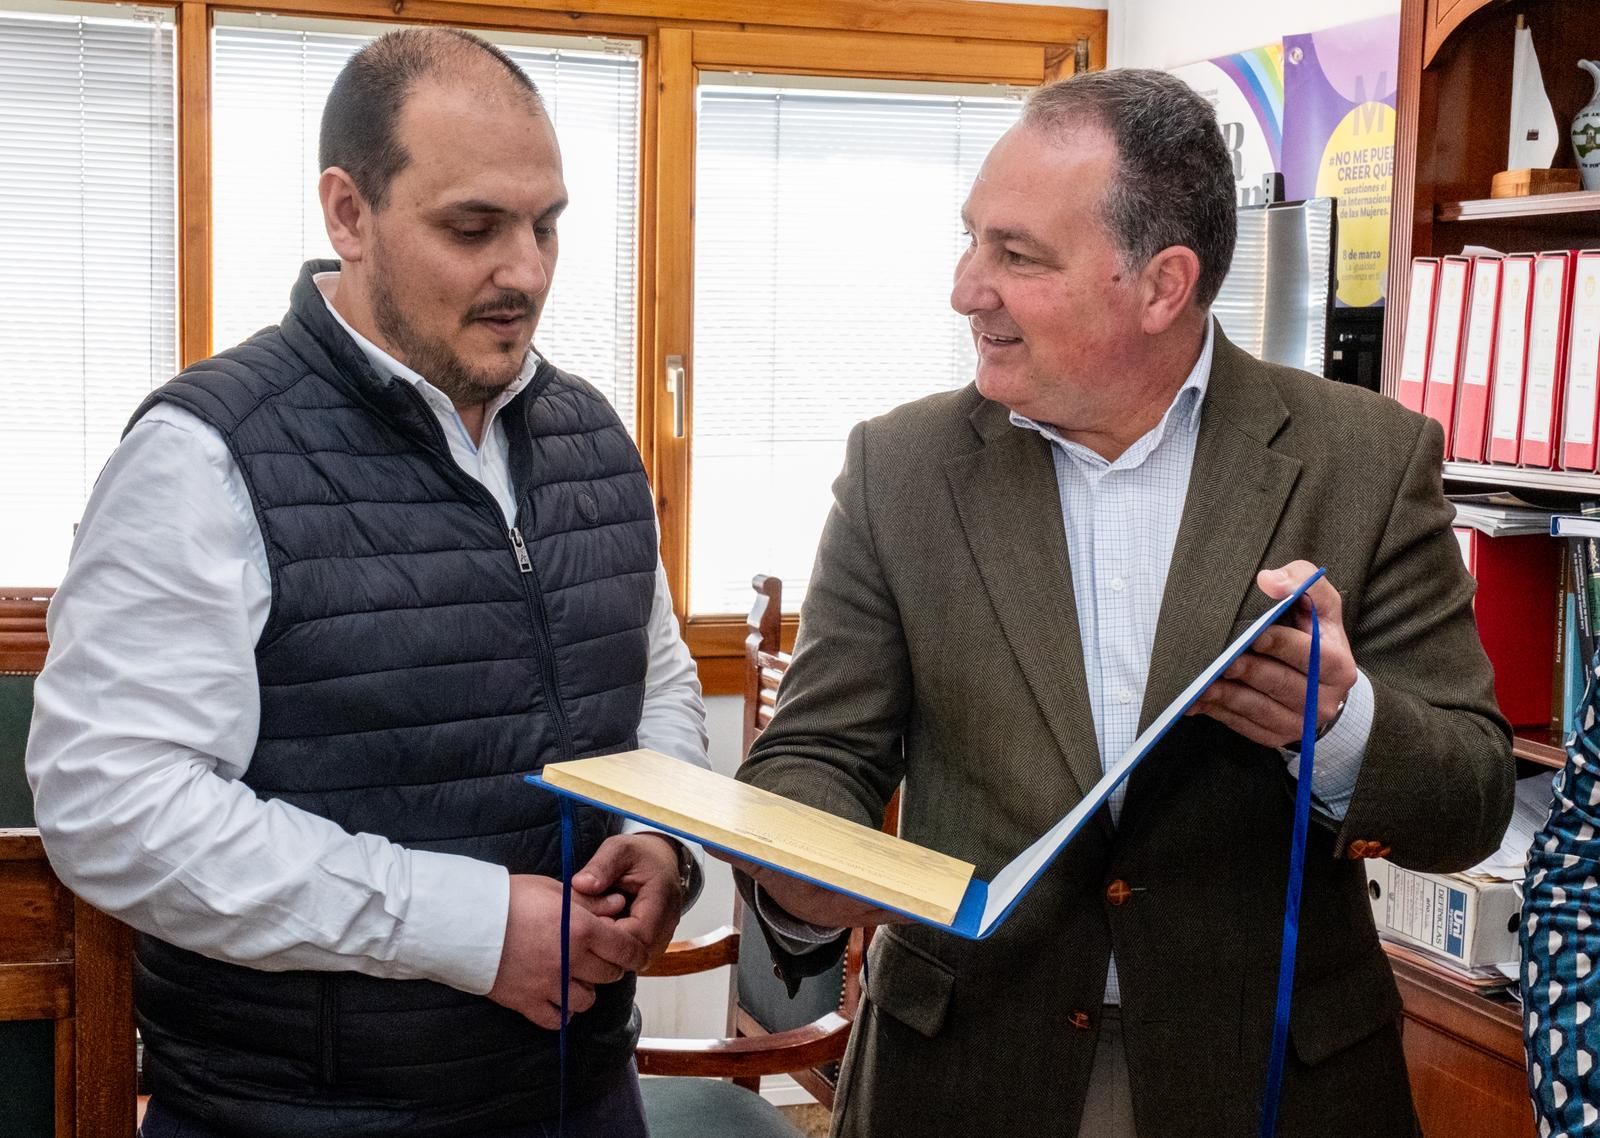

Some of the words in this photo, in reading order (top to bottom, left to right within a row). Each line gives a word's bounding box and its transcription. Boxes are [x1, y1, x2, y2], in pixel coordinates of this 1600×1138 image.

[1353, 148, 1369, 164] ME
[1338, 164, 1371, 181] CREER
[1373, 161, 1393, 179] QUE
[1344, 182, 1379, 194] cuestiones
[1381, 180, 1387, 191] el
[1340, 208, 1348, 218] de
[1349, 207, 1359, 218] las
[1348, 249, 1357, 260] de
[1358, 251, 1381, 259] marzo
[1435, 888, 1445, 945] DEFINICLAS
[1452, 909, 1463, 939] Uni
